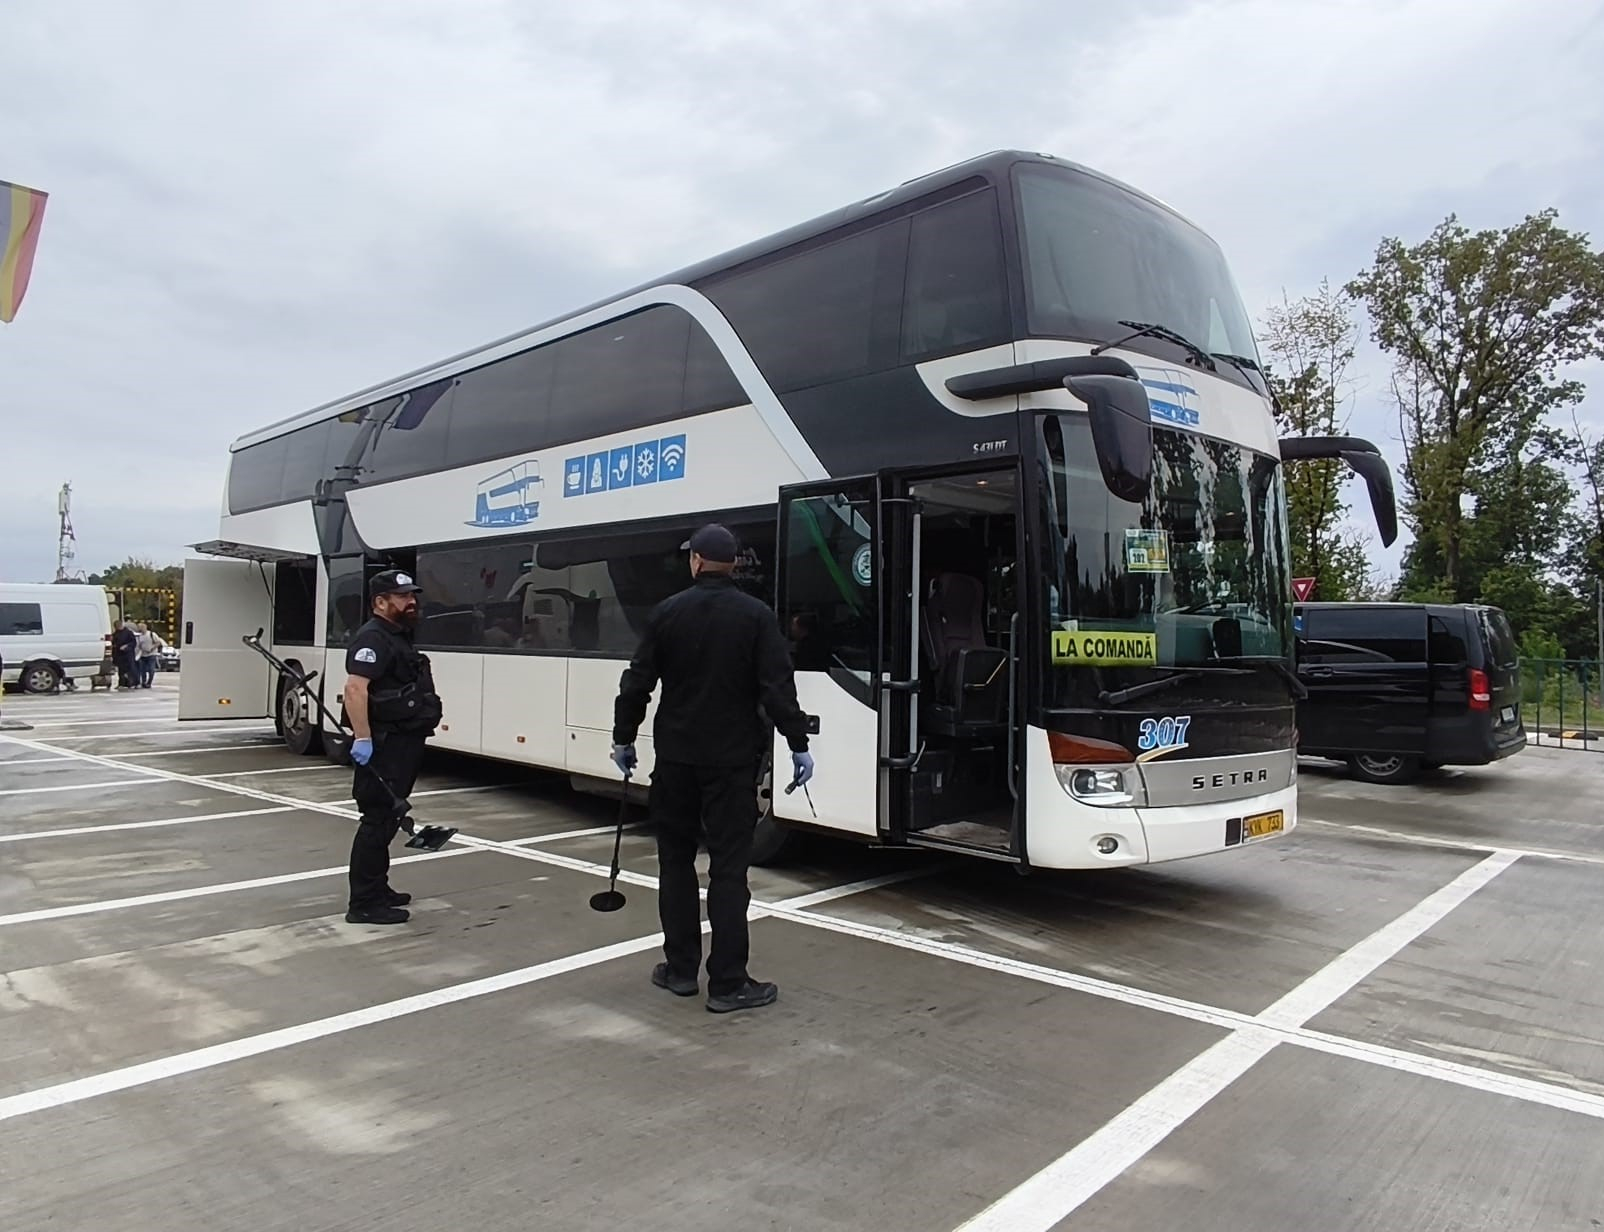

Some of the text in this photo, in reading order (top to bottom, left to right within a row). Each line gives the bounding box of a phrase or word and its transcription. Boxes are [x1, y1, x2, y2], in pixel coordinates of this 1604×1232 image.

[1056, 636, 1153, 659] LA COMANDĂ
[1138, 715, 1191, 750] 307
[1192, 769, 1268, 790] SETRA
